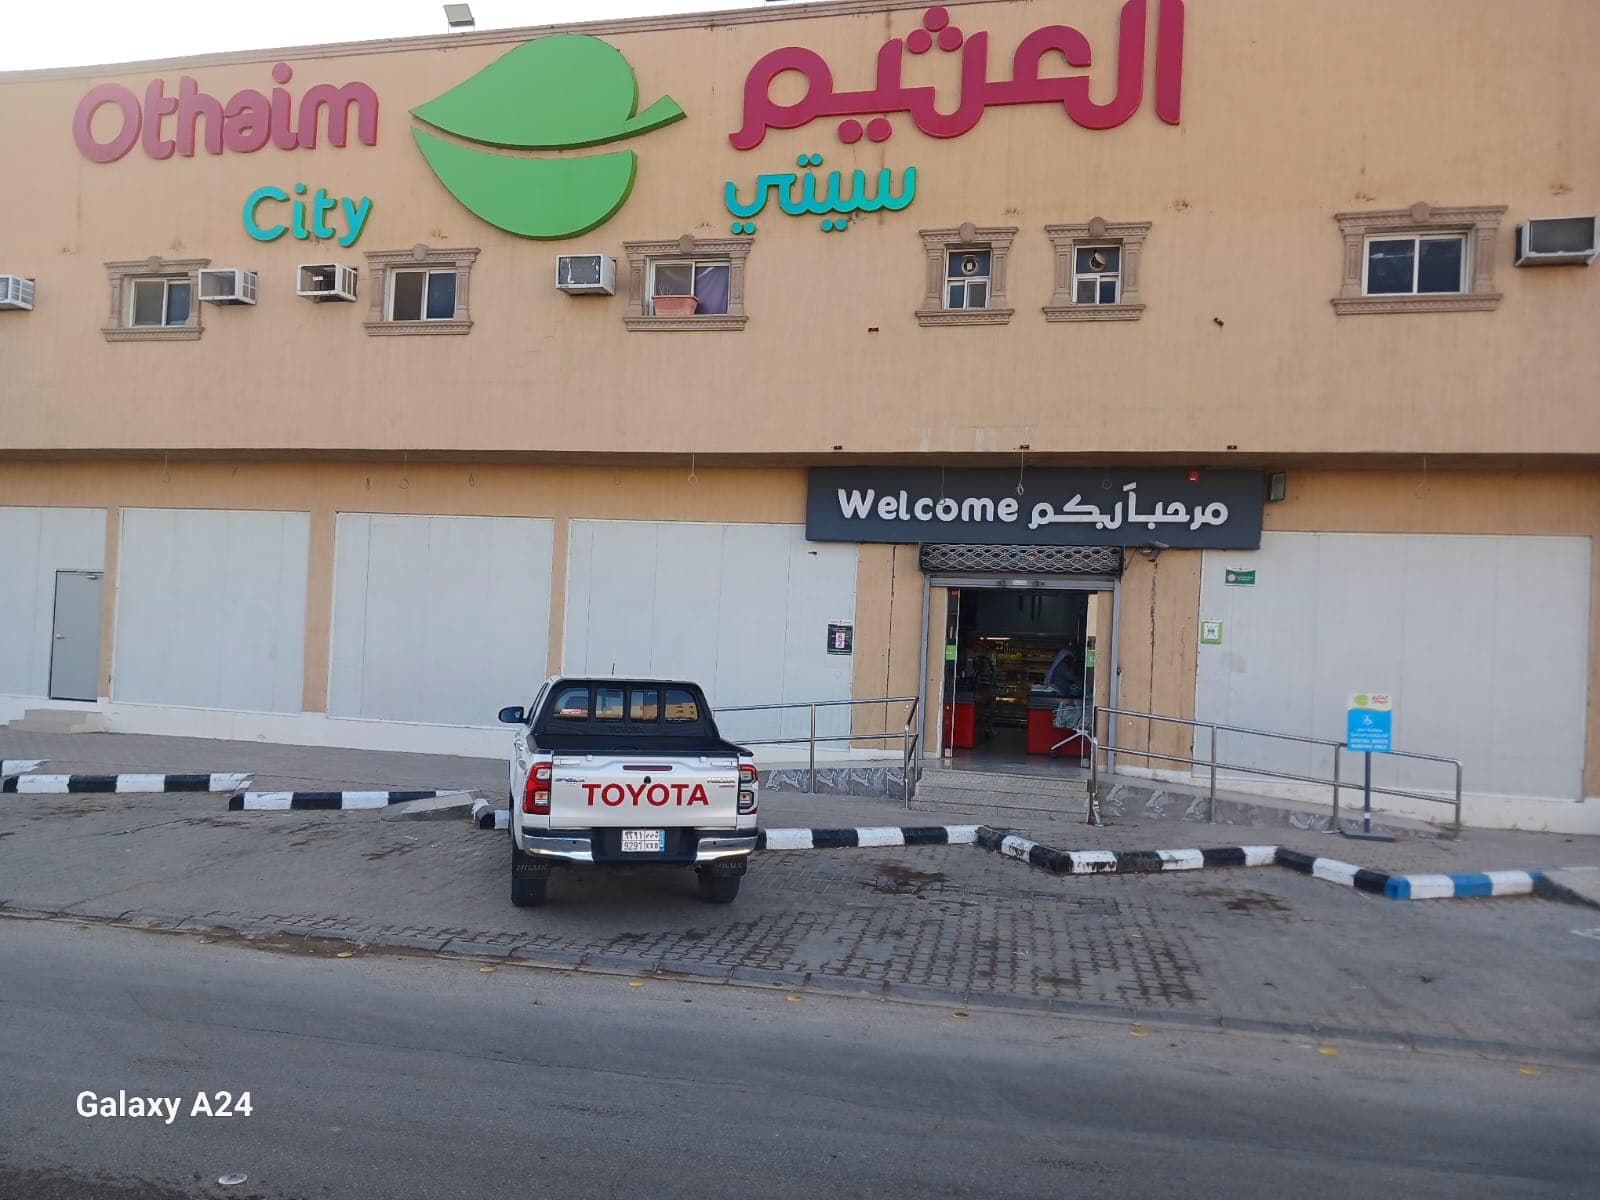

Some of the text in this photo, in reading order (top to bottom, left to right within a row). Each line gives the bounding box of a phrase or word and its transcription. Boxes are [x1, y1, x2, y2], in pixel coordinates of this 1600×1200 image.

[728, 0, 1186, 151] العثيم
[72, 61, 379, 164] Othaim
[242, 182, 373, 248] City
[724, 152, 917, 235] سيتي
[837, 488, 1019, 523] Welcome
[1027, 493, 1123, 530] بكم
[581, 783, 710, 807] TOYOTA
